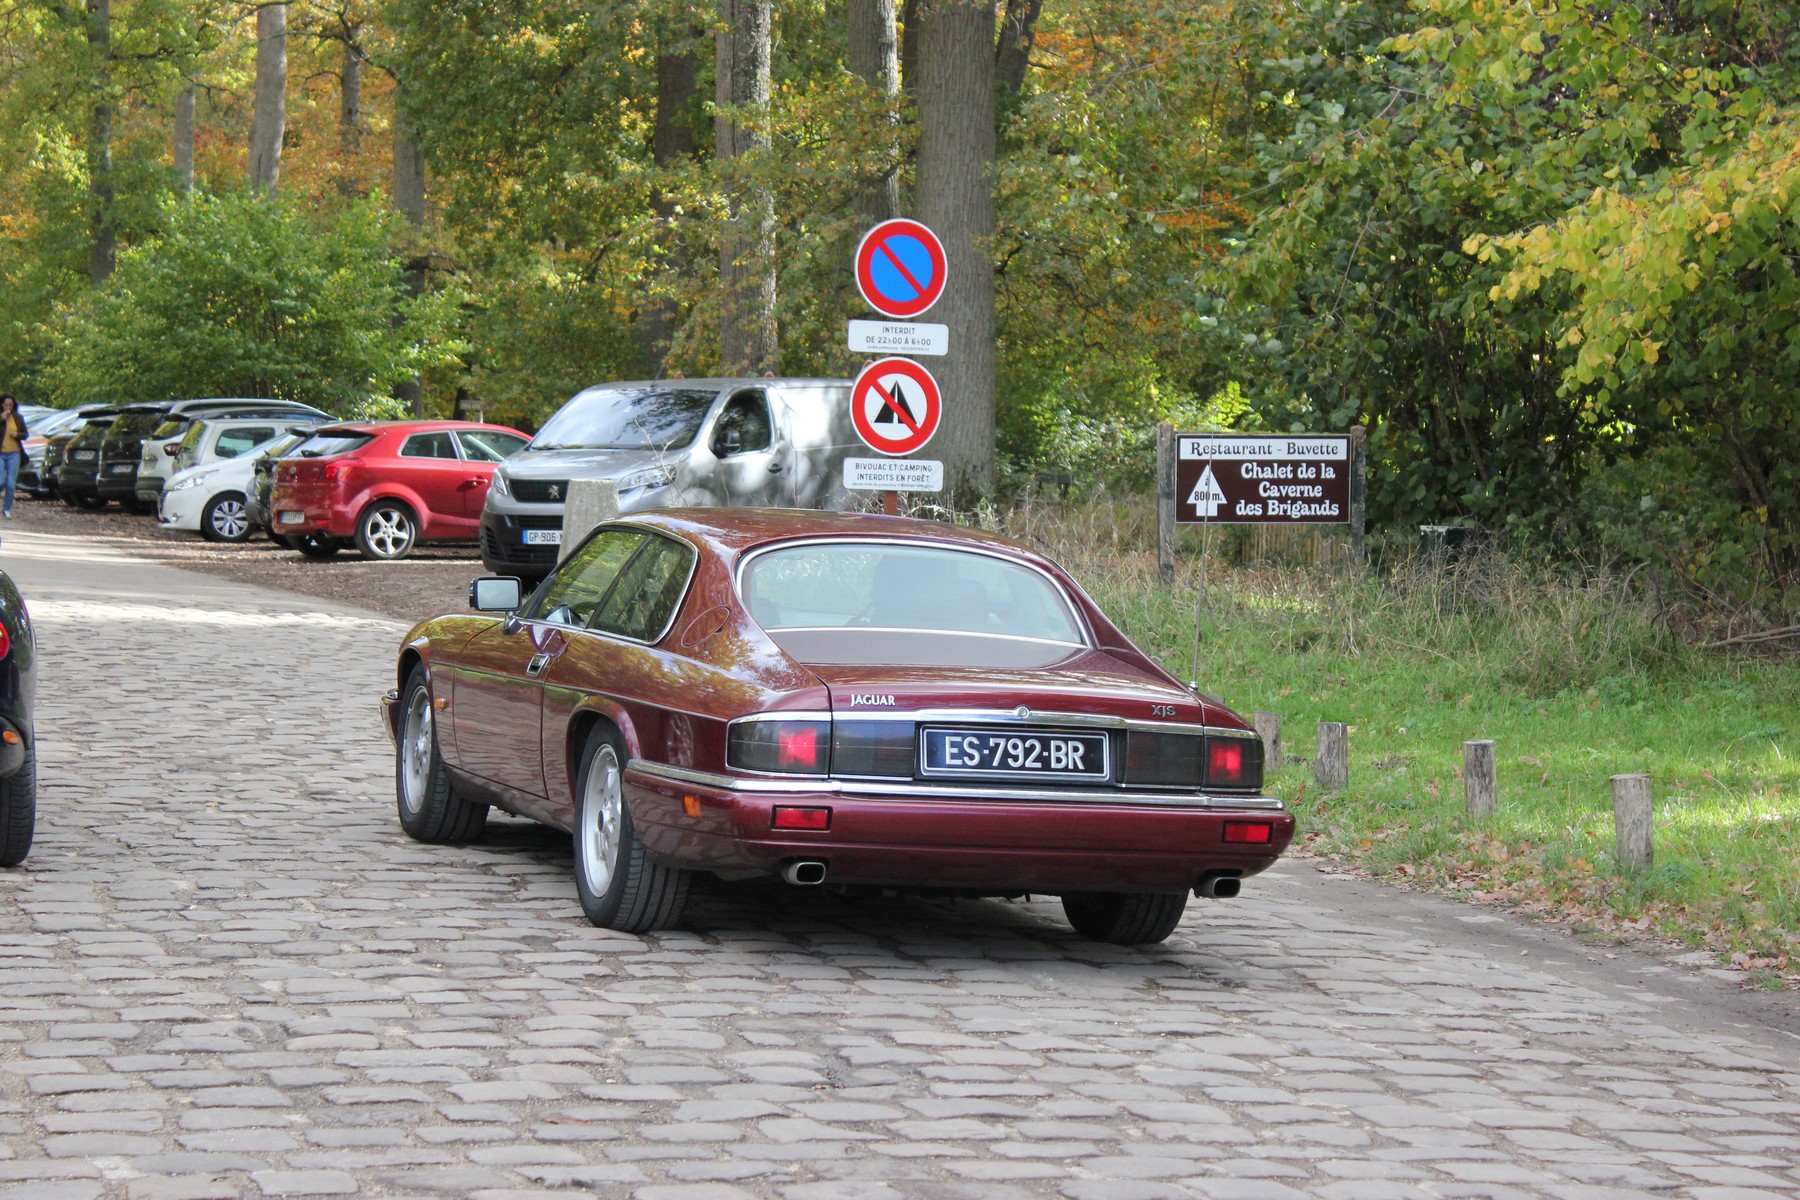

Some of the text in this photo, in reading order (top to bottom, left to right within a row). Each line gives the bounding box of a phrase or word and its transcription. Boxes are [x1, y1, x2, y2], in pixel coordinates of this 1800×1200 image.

[882, 326, 916, 335] INTERDIT
[866, 335, 932, 346] DE 22h00 À 6h00
[1190, 441, 1273, 456] Restaurant
[1286, 441, 1339, 455] Buvette
[855, 462, 933, 472] BIVOUAC ET CAMPING
[1240, 461, 1336, 480] Chalet de la
[857, 473, 930, 483] INTERDITS EN FORÊT
[1258, 480, 1323, 498] Caverne
[1235, 499, 1340, 519] des Brigands
[850, 693, 896, 707] JAGUAR
[1151, 704, 1177, 718] XJS
[945, 735, 1085, 770] ES-792-BR
